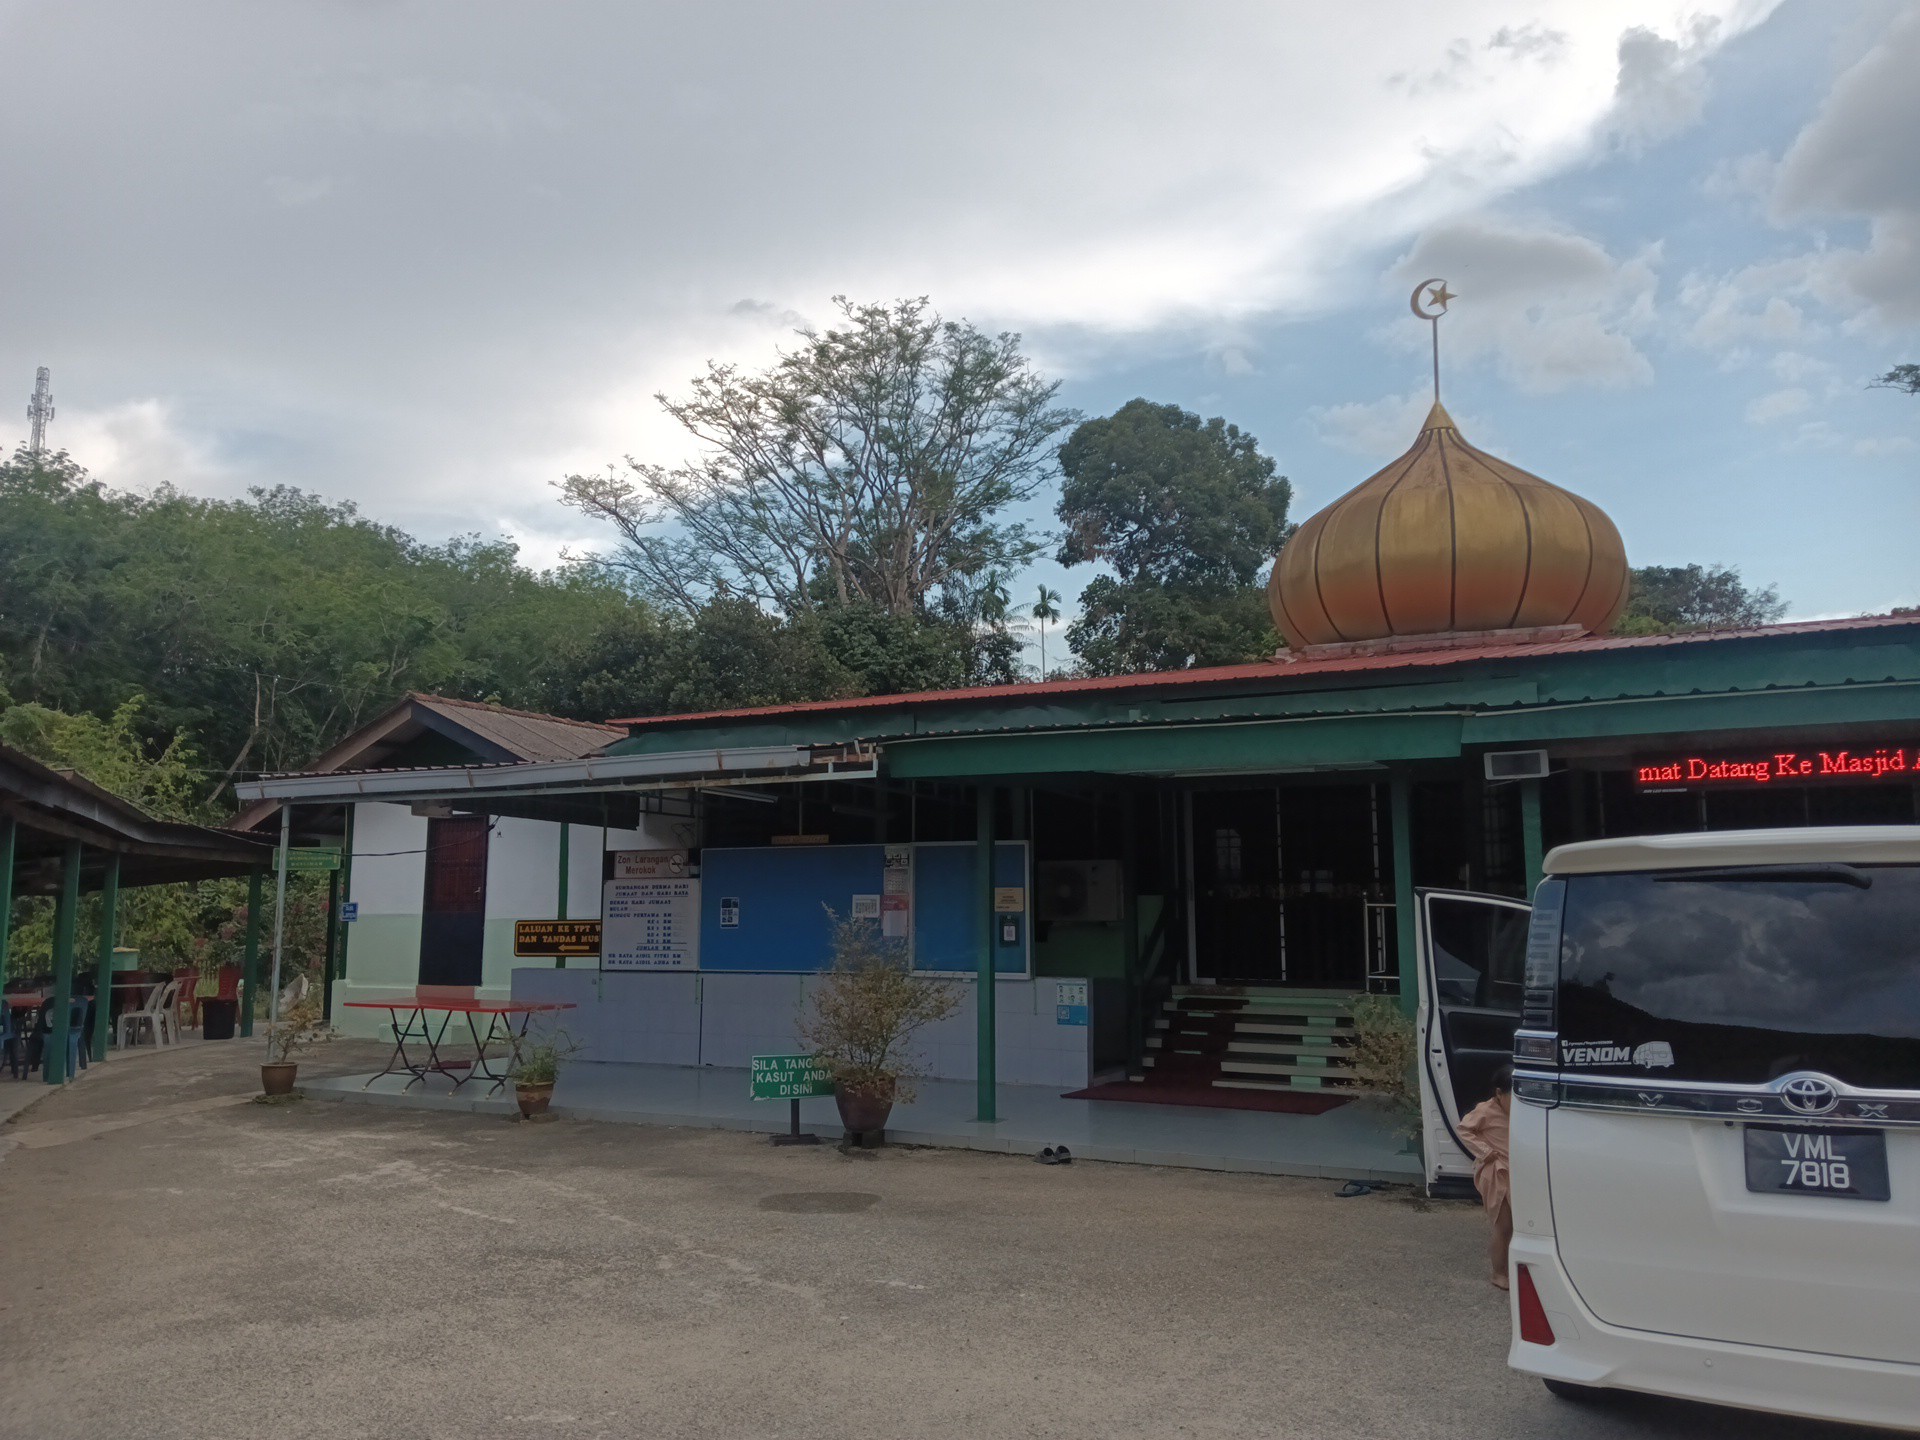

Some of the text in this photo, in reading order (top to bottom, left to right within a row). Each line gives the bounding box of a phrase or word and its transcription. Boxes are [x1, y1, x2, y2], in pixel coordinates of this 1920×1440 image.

[1639, 763, 1682, 781] mat
[1687, 759, 1770, 781] Datang
[1774, 754, 1813, 775] Ke
[1819, 750, 1906, 777] Masjid
[617, 855, 669, 865] Zon Larangan
[625, 866, 657, 875] Merokok
[519, 925, 553, 933] LALUAN
[518, 935, 538, 943] DAN
[542, 935, 577, 943] TANDAS
[1562, 1046, 1631, 1063] VENOM
[752, 1060, 779, 1071] SILA
[756, 1070, 833, 1083] KASUT ANDA
[1782, 1133, 1847, 1161] VML
[1781, 1160, 1851, 1189] 7818
